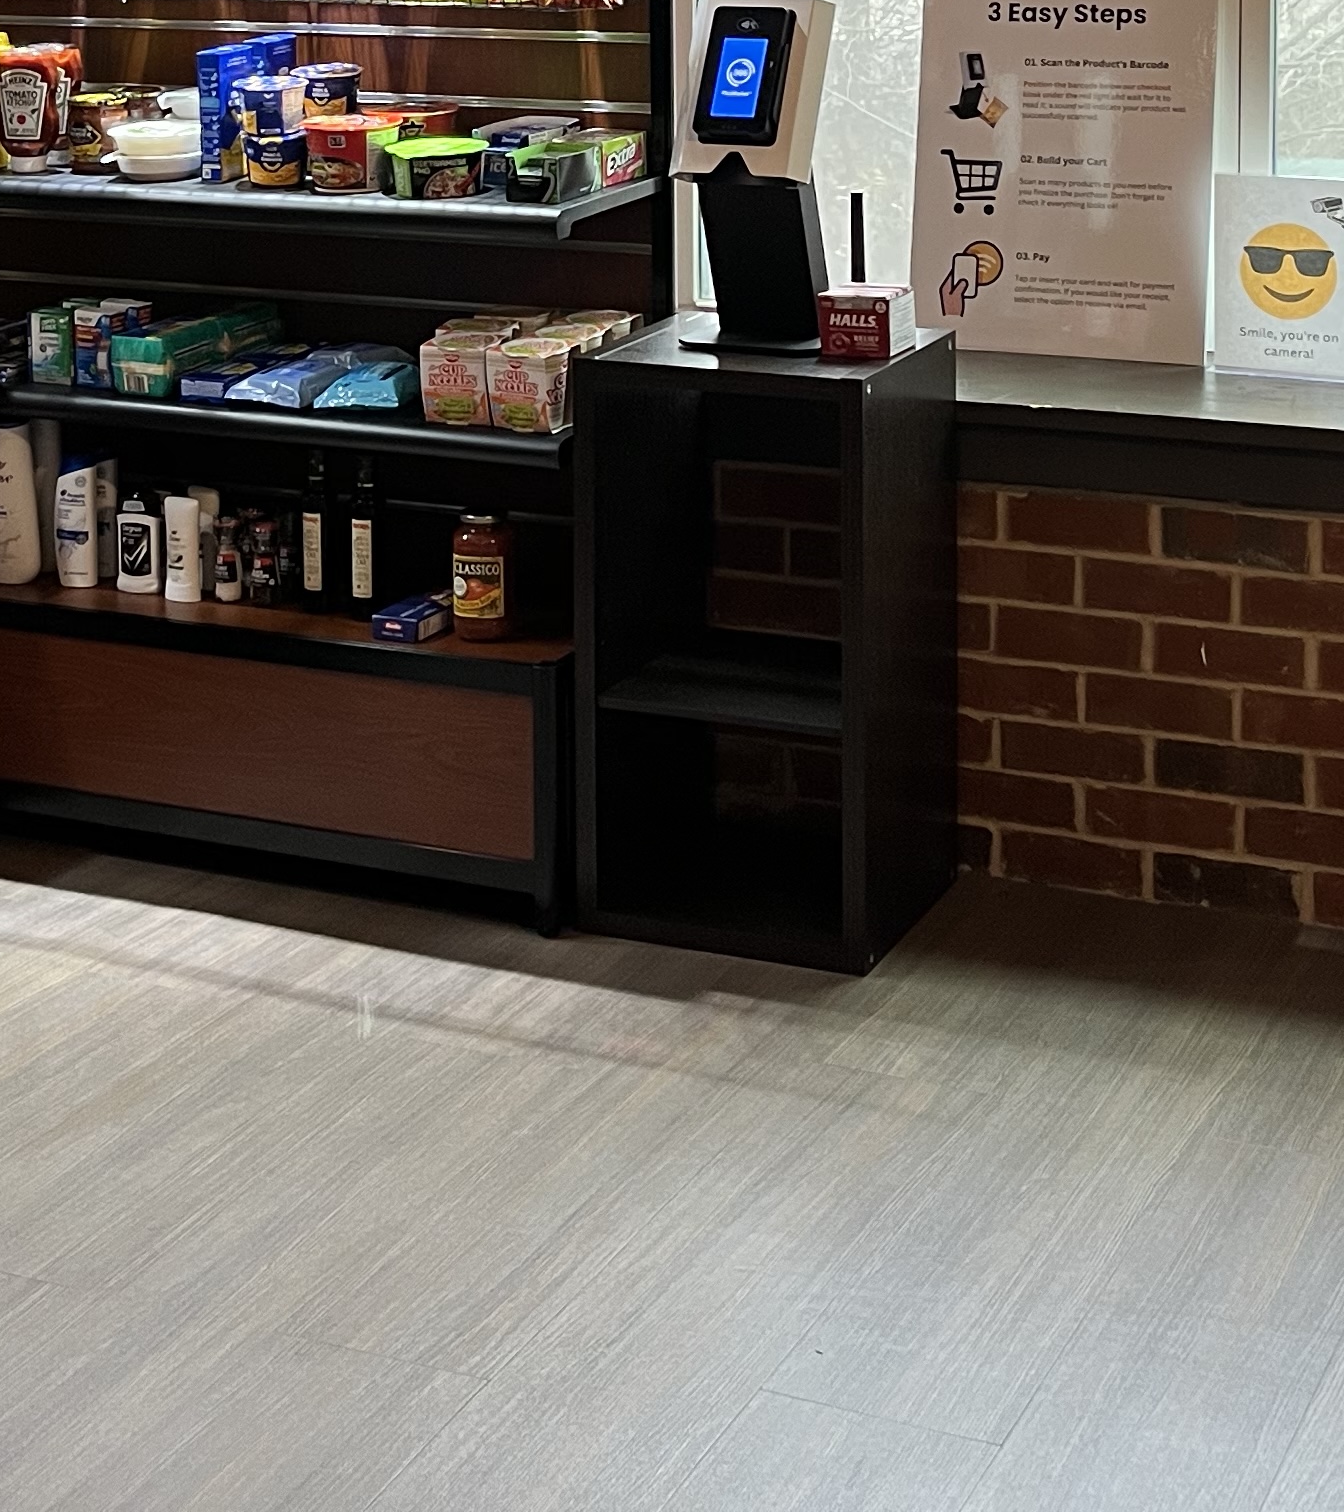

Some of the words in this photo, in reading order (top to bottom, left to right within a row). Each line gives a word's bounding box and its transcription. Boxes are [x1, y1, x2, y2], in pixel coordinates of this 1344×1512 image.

[988, 2, 1001, 22] 3
[1009, 3, 1067, 29] Easy
[1074, 4, 1147, 30] Steps
[1041, 59, 1062, 67] Scan
[1083, 60, 1127, 68] Product's
[1130, 61, 1169, 69] Barcode
[9, 77, 32, 85] HEINZ
[5, 90, 38, 99] TOMATO
[7, 98, 36, 106] KETCHUP
[607, 143, 636, 176] Extra
[1063, 157, 1084, 166] your
[1087, 158, 1107, 166] Cart
[1016, 252, 1029, 260] 03.
[1033, 253, 1050, 262] Pay
[829, 313, 876, 327] HALLS
[1239, 326, 1278, 340] Smile,
[1280, 330, 1320, 343] you're
[1323, 333, 1339, 343] on
[1264, 347, 1314, 359] camera!
[439, 364, 467, 375] CUP
[429, 374, 477, 387] NOODLES
[504, 370, 529, 382] CUP
[495, 380, 539, 396] NOODLES
[454, 561, 500, 577] CLASSICO
